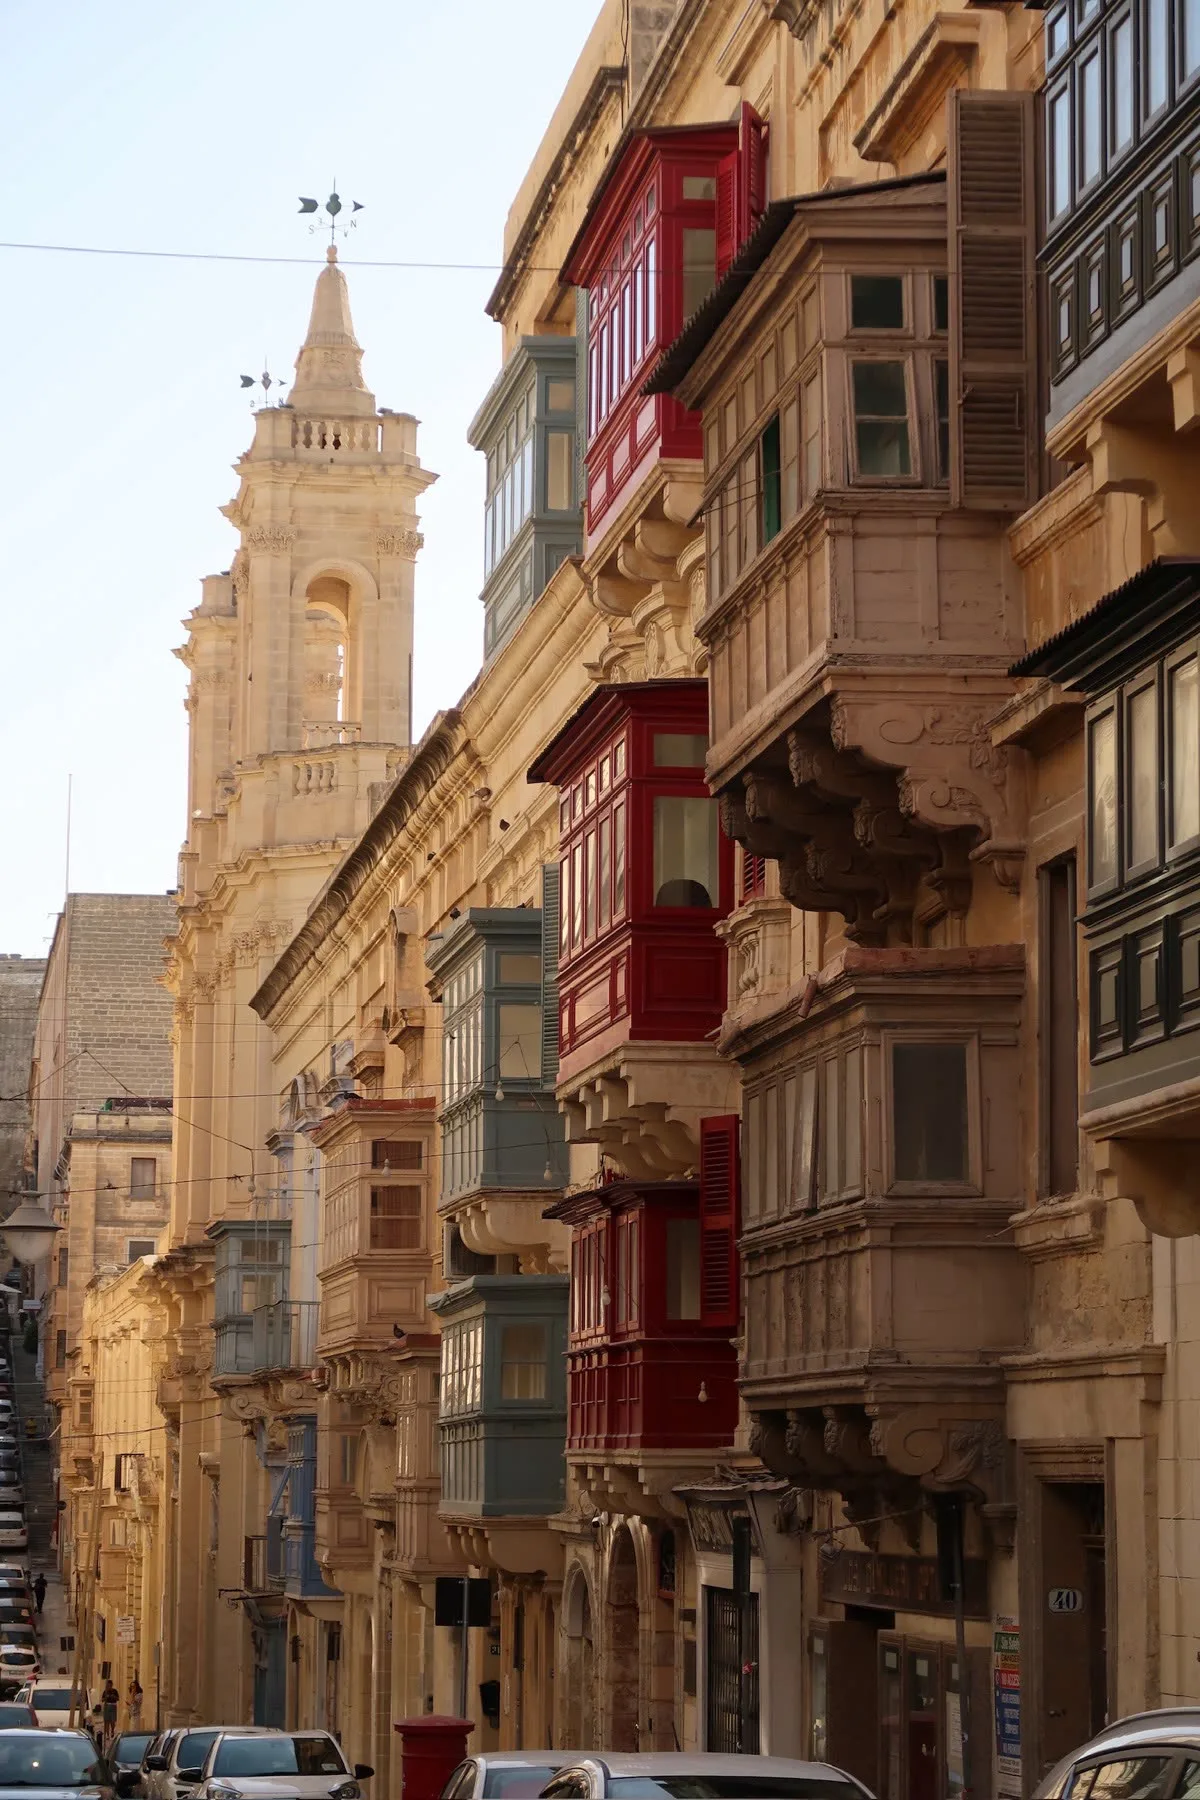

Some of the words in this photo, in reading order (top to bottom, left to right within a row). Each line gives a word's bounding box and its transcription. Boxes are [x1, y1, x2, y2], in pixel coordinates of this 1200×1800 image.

[350, 219, 357, 228] N
[309, 224, 314, 235] S
[1053, 1591, 1078, 1609] 40
